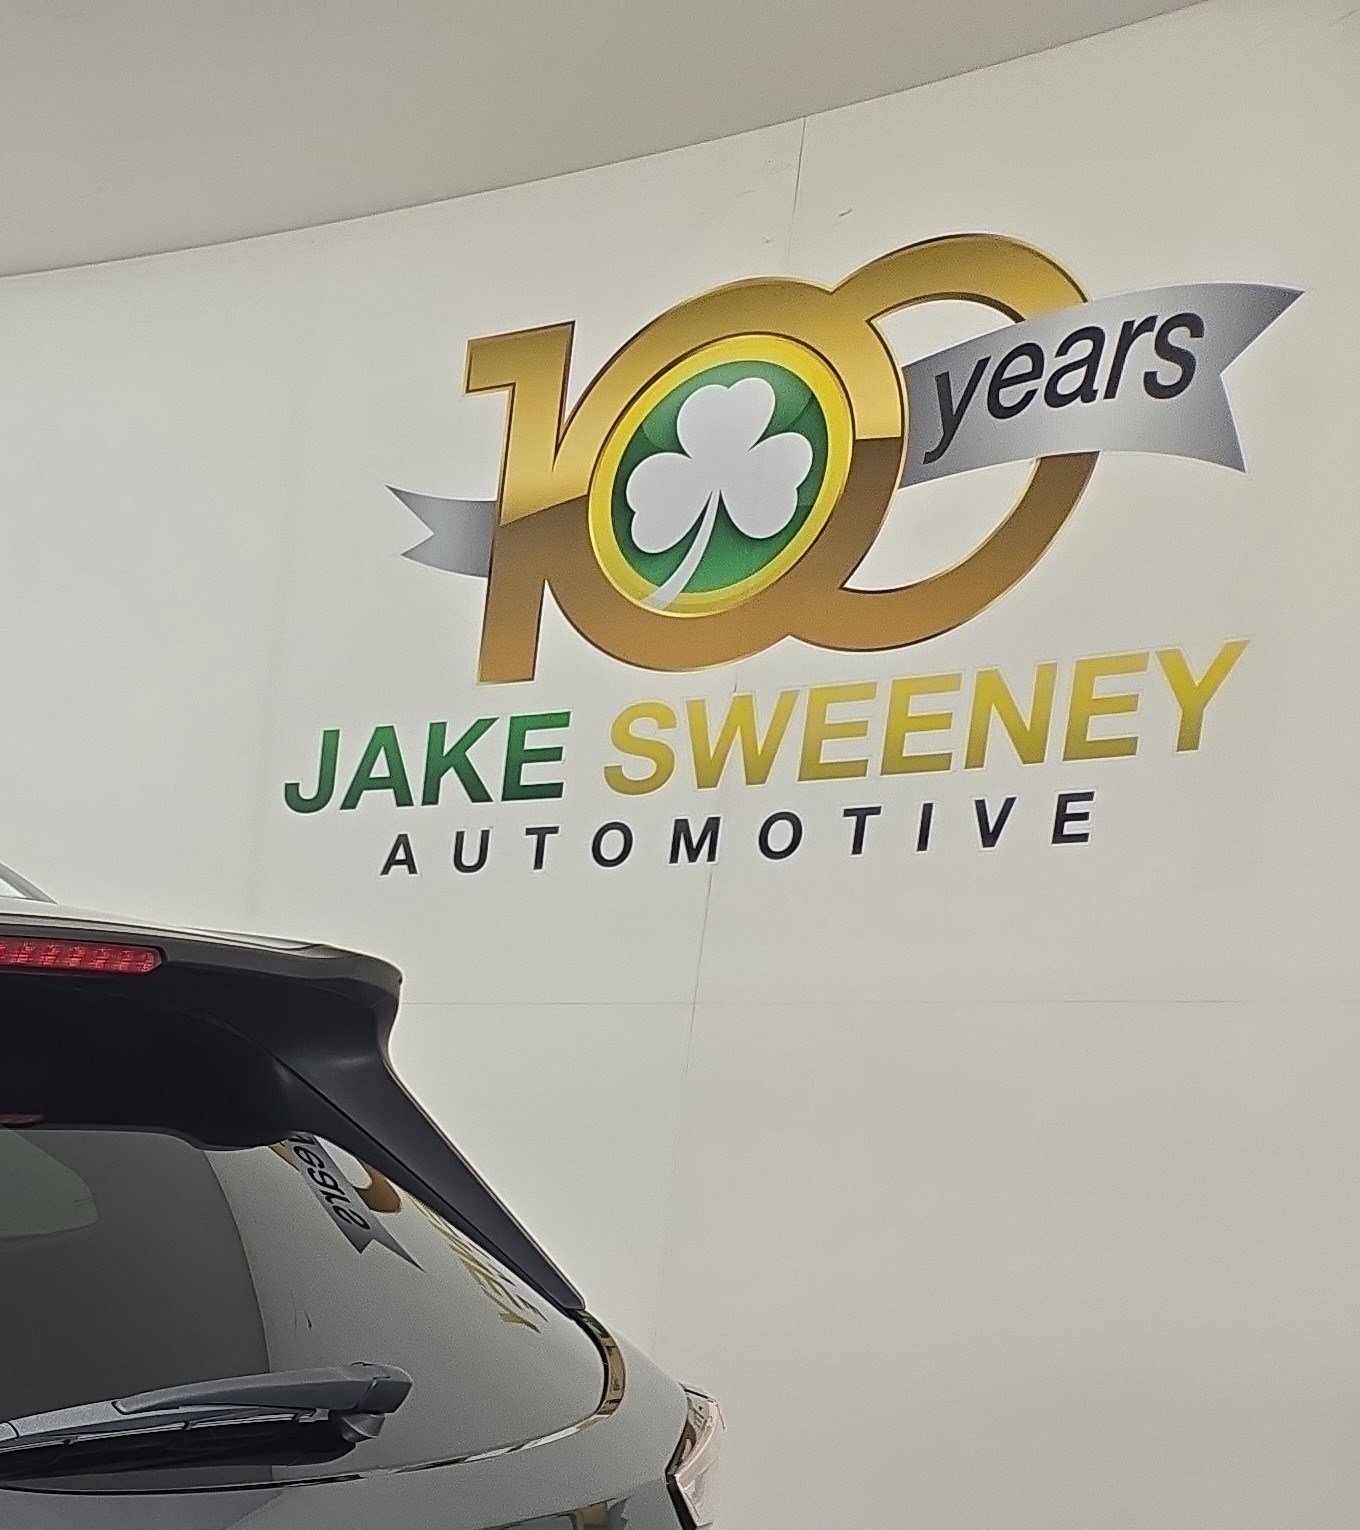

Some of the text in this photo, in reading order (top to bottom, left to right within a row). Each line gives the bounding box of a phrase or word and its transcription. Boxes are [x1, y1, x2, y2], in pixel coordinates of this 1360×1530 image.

[921, 308, 1205, 466] years
[283, 639, 1250, 815] JAKE SWEENEY
[379, 791, 1096, 878] AUTOMOTIVE
